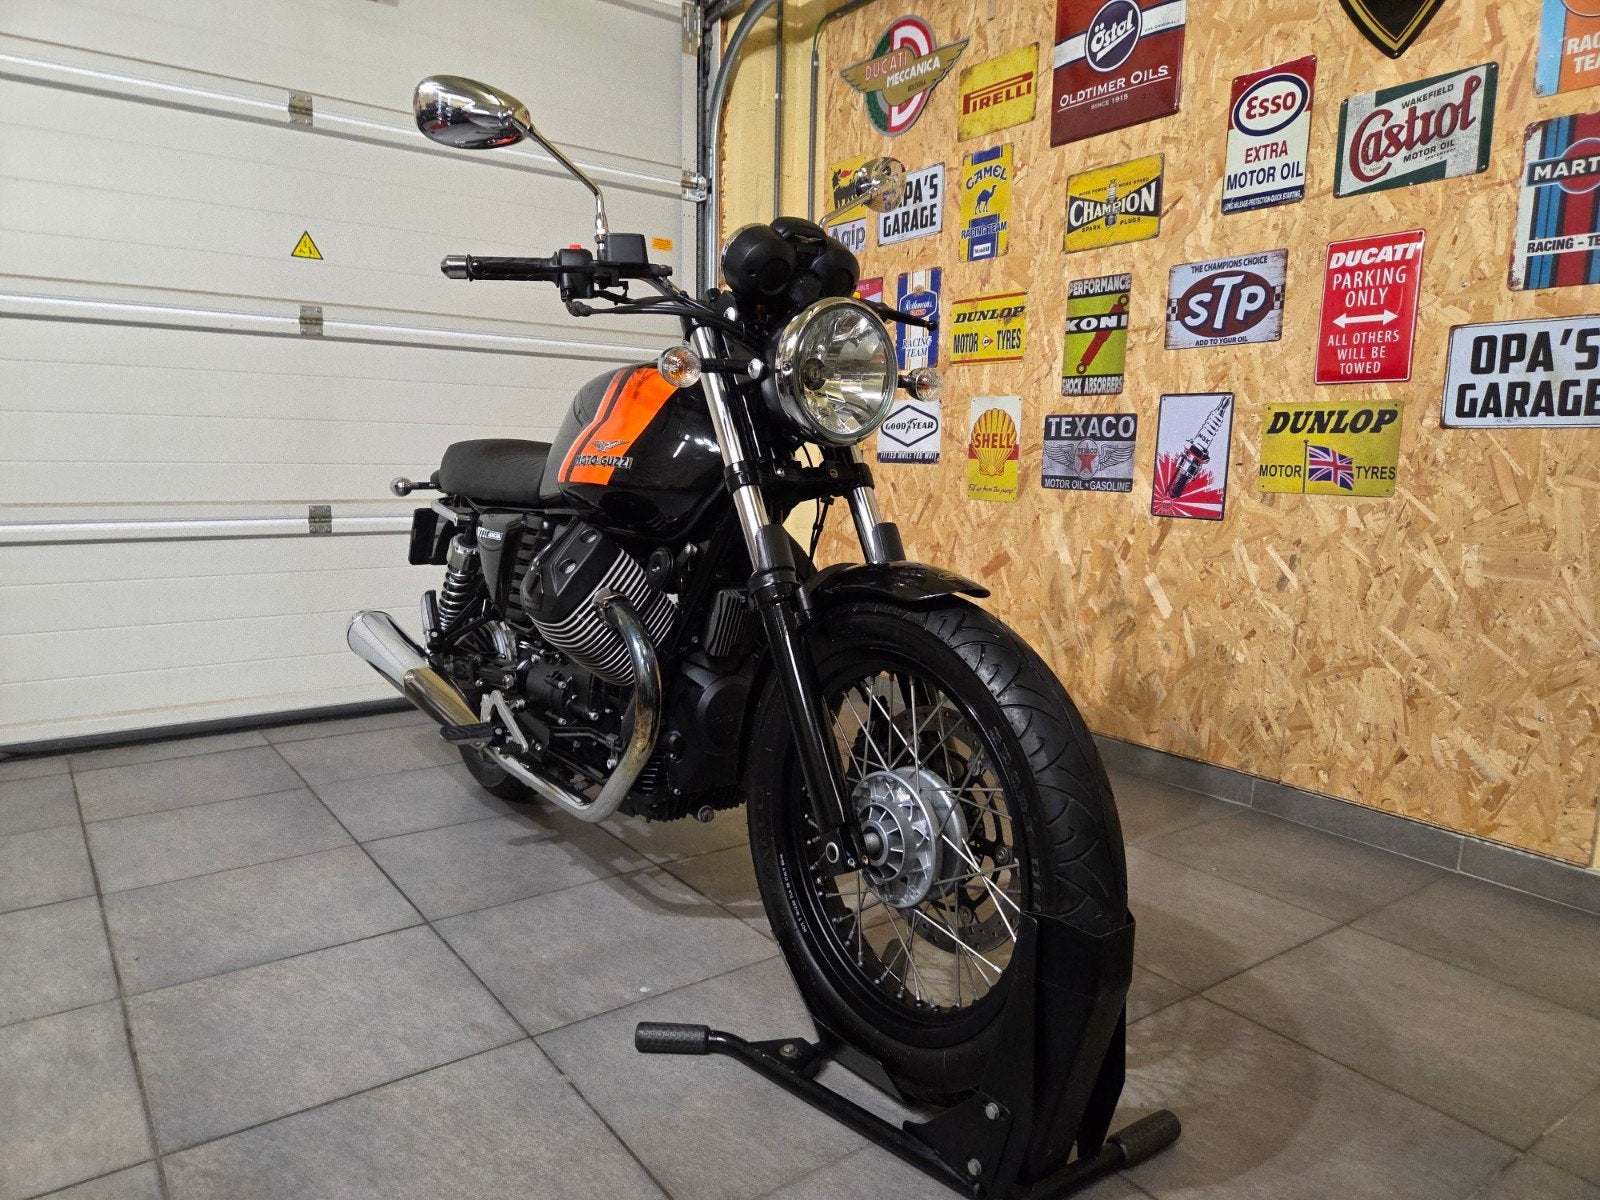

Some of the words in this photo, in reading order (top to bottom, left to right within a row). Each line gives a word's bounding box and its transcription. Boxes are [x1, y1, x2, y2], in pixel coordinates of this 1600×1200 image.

[866, 51, 908, 81] DUCATI
[887, 56, 941, 88] MECCANICA
[963, 71, 1034, 115] PIRELLI
[1060, 77, 1126, 107] OLDTIMER
[1130, 65, 1169, 84] OILS
[1401, 83, 1454, 109] WAKEFIELD
[1090, 100, 1109, 110] SINCE
[1111, 93, 1129, 104] 1915
[1349, 75, 1482, 182] Castrol
[1244, 140, 1288, 164] EXTRA
[1403, 147, 1436, 163] MOTOR
[1440, 139, 1455, 151] OIL
[966, 165, 1007, 190] CAMEL
[1227, 166, 1277, 190] MOTOR
[1281, 161, 1304, 180] OIL
[899, 173, 938, 208] PA'S
[1070, 181, 1157, 227] CHAMPION
[883, 204, 937, 238] GARAGE
[961, 224, 988, 239] RACING
[987, 221, 1007, 236] TEAM
[1081, 225, 1101, 233] SPARK
[1120, 216, 1141, 225] PLUGS
[1329, 241, 1420, 270] DUCATI
[1527, 237, 1574, 253] RACING
[1191, 262, 1204, 274] THE
[1204, 258, 1243, 271] CHAMPIONS
[1243, 255, 1269, 268] CHOICE
[1068, 274, 1131, 297] PERFORMANCE
[1333, 265, 1407, 290] PARKING
[1184, 274, 1267, 330] STP
[1345, 286, 1389, 308] ONLY
[953, 305, 1025, 324] DUNLOP
[1066, 314, 1129, 331] KONI
[903, 336, 932, 349] RACING
[953, 332, 979, 353] MOTOR
[996, 328, 1021, 350] TYRES
[1195, 338, 1209, 346] ADD
[1210, 337, 1219, 345] TO
[1219, 336, 1237, 344] YOUR
[1237, 335, 1249, 343] OIL
[1327, 334, 1348, 346] ALL
[1353, 329, 1400, 344] OTHERS
[906, 348, 928, 358] TEAM
[1337, 347, 1366, 360] WILL
[1371, 345, 1386, 358] BE
[1470, 328, 1600, 375] OPA'S
[1340, 361, 1381, 375] TOWED
[1084, 376, 1124, 394] ABSORBERS
[1455, 379, 1600, 418] GARAGE
[1048, 416, 1135, 438] TEXACO
[1266, 409, 1398, 434] DUNLOP
[974, 432, 1013, 450] SHELL
[1259, 464, 1302, 478] MOTOR
[1355, 466, 1397, 480] TYRES
[1045, 478, 1070, 489] MOTOR
[1072, 480, 1085, 490] OIL
[1090, 481, 1132, 491] GASOLINE
